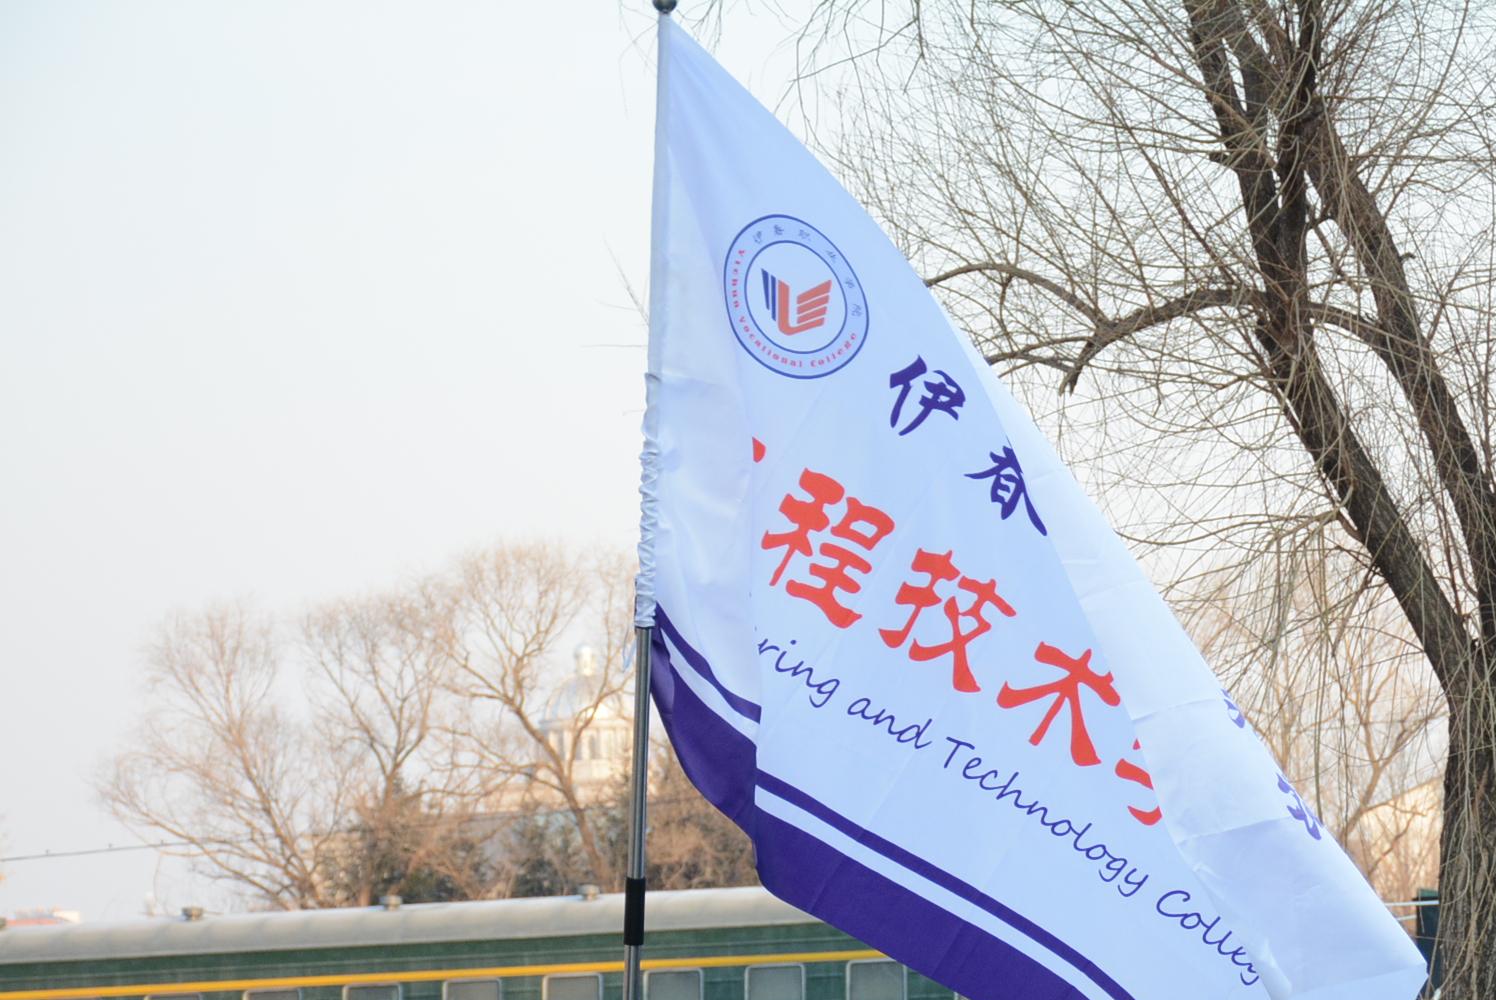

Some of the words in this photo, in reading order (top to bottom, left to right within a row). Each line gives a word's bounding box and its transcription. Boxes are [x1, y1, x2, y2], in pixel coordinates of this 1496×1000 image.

[810, 333, 857, 367] College
[752, 437, 1163, 826] 程技术
[847, 698, 933, 750] and
[943, 736, 1149, 897] Technology
